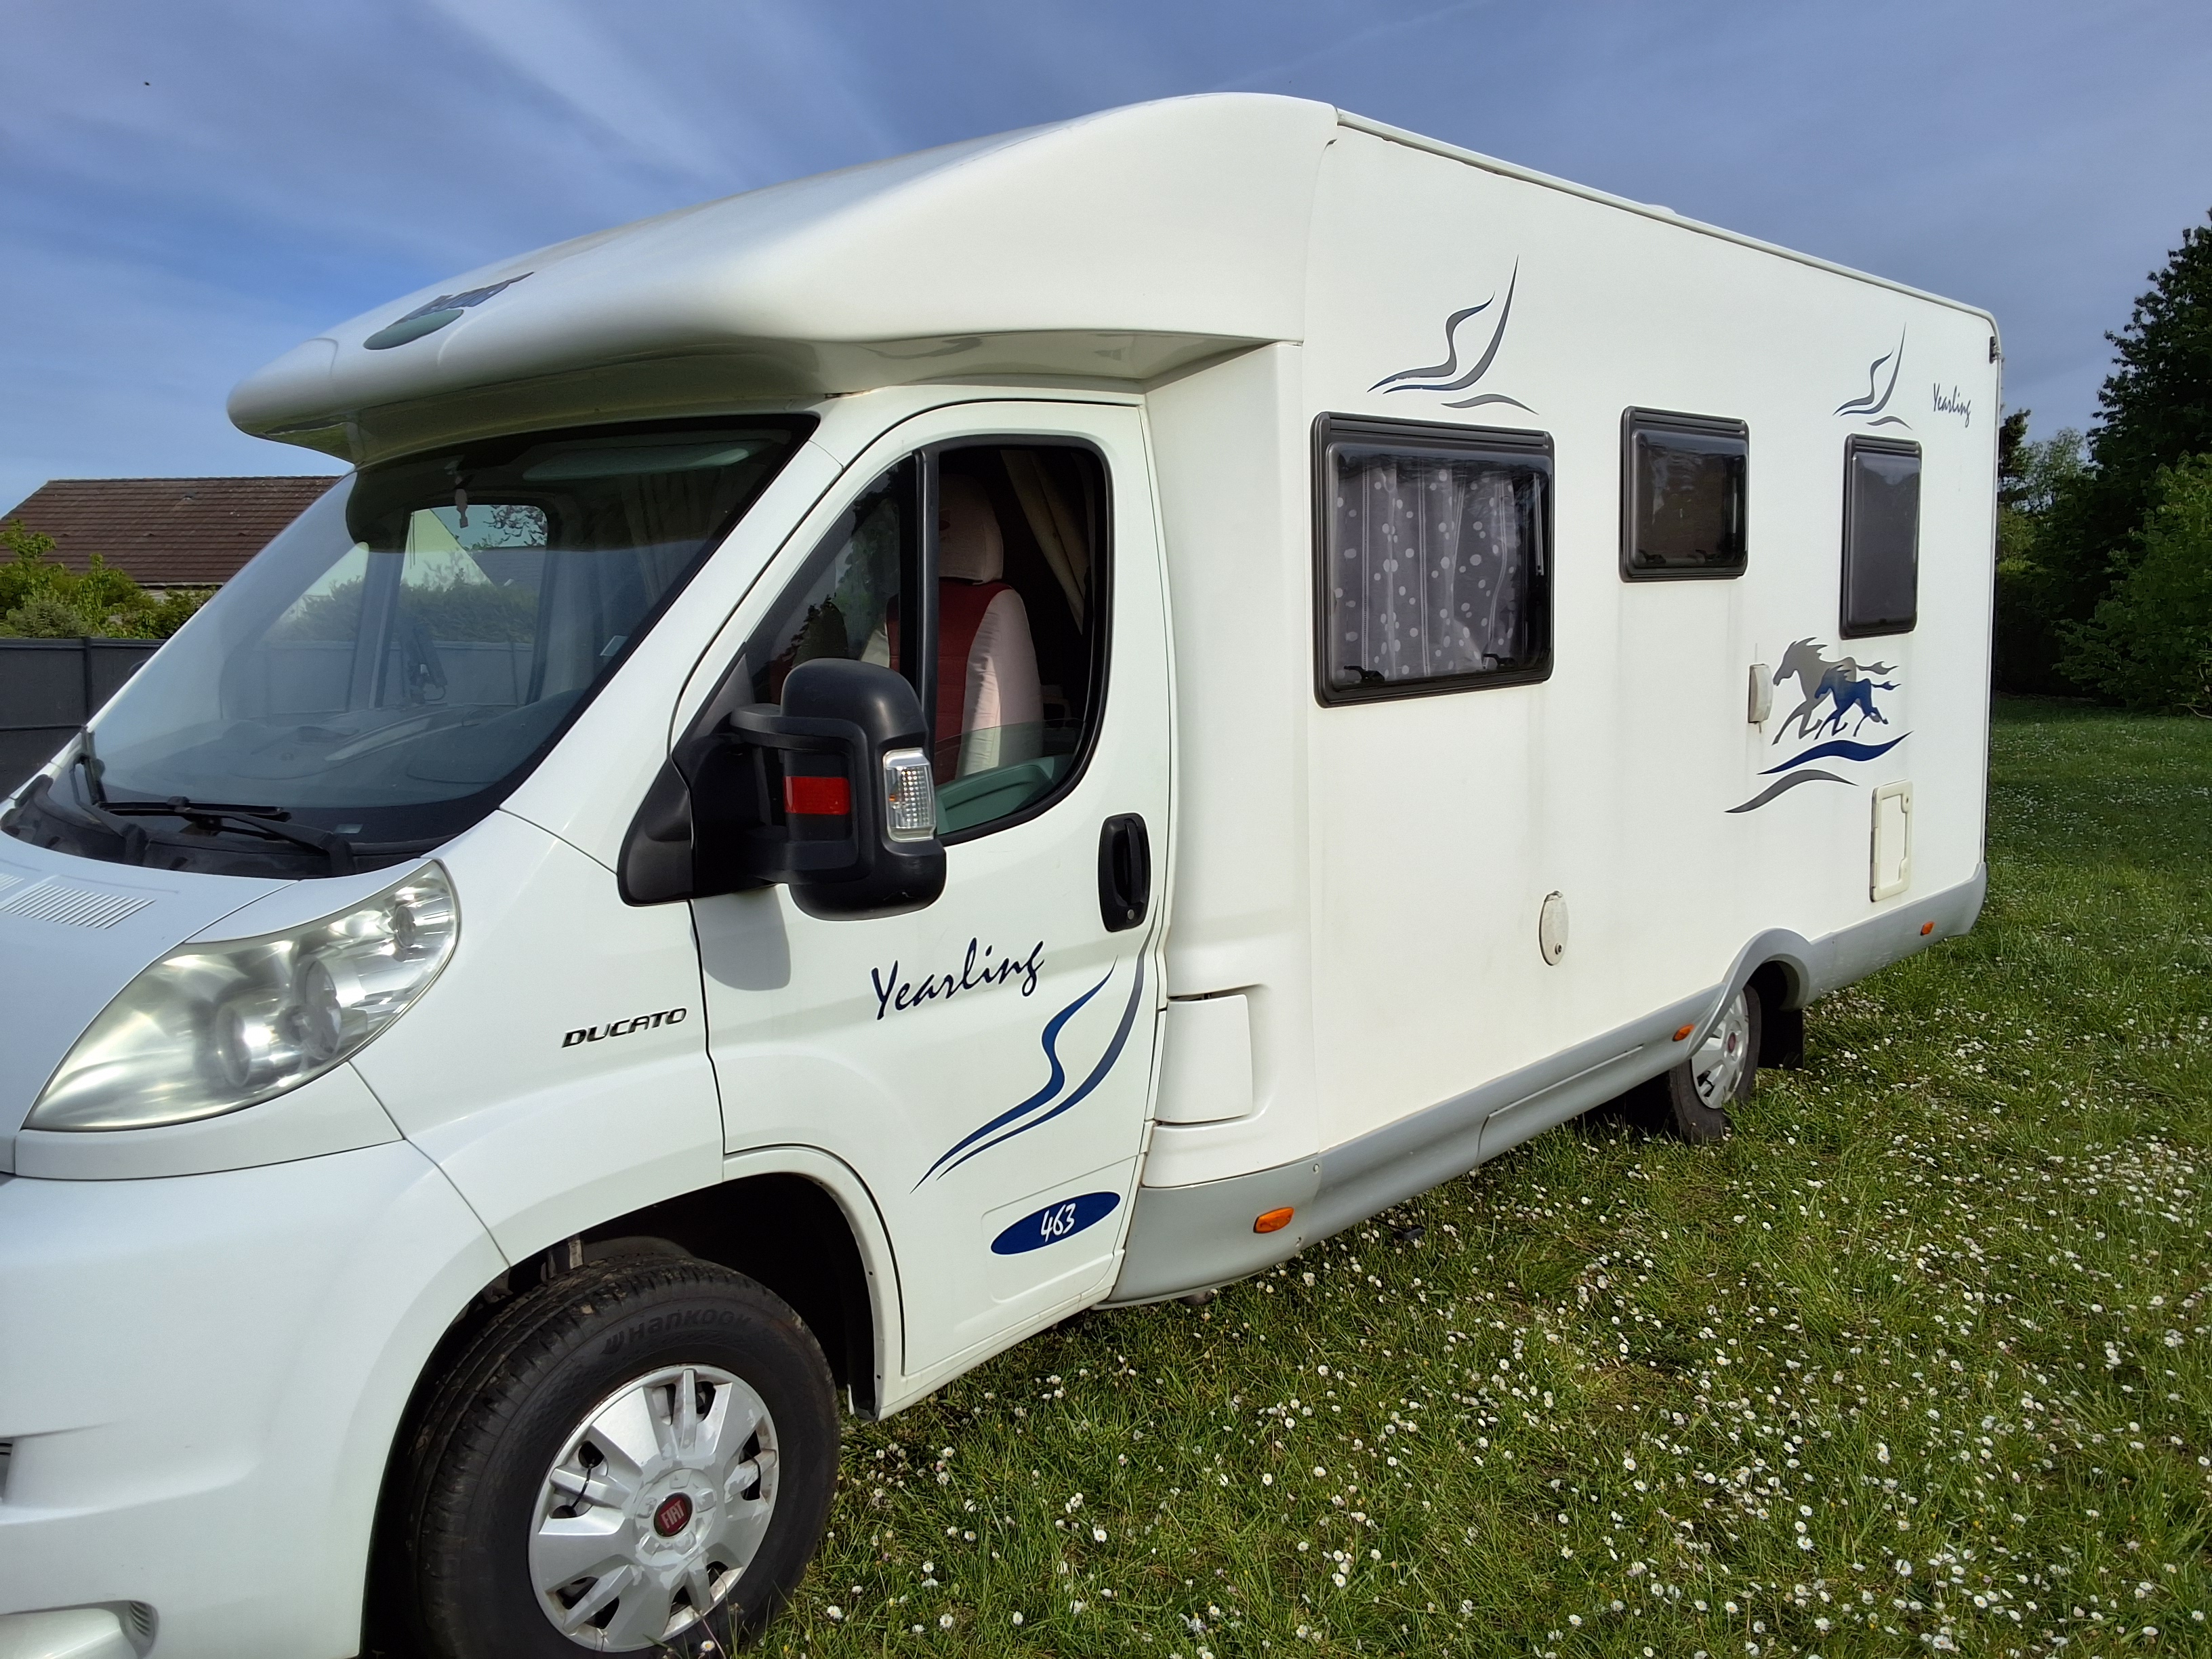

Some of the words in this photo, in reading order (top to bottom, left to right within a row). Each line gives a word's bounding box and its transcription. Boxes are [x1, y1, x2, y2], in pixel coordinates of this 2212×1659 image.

[1933, 382, 1971, 428] Yearling
[871, 937, 1044, 1021] Yearling
[561, 1006, 688, 1048] DUCATO
[1041, 1203, 1076, 1242] 463
[661, 1500, 684, 1529] FIAT
